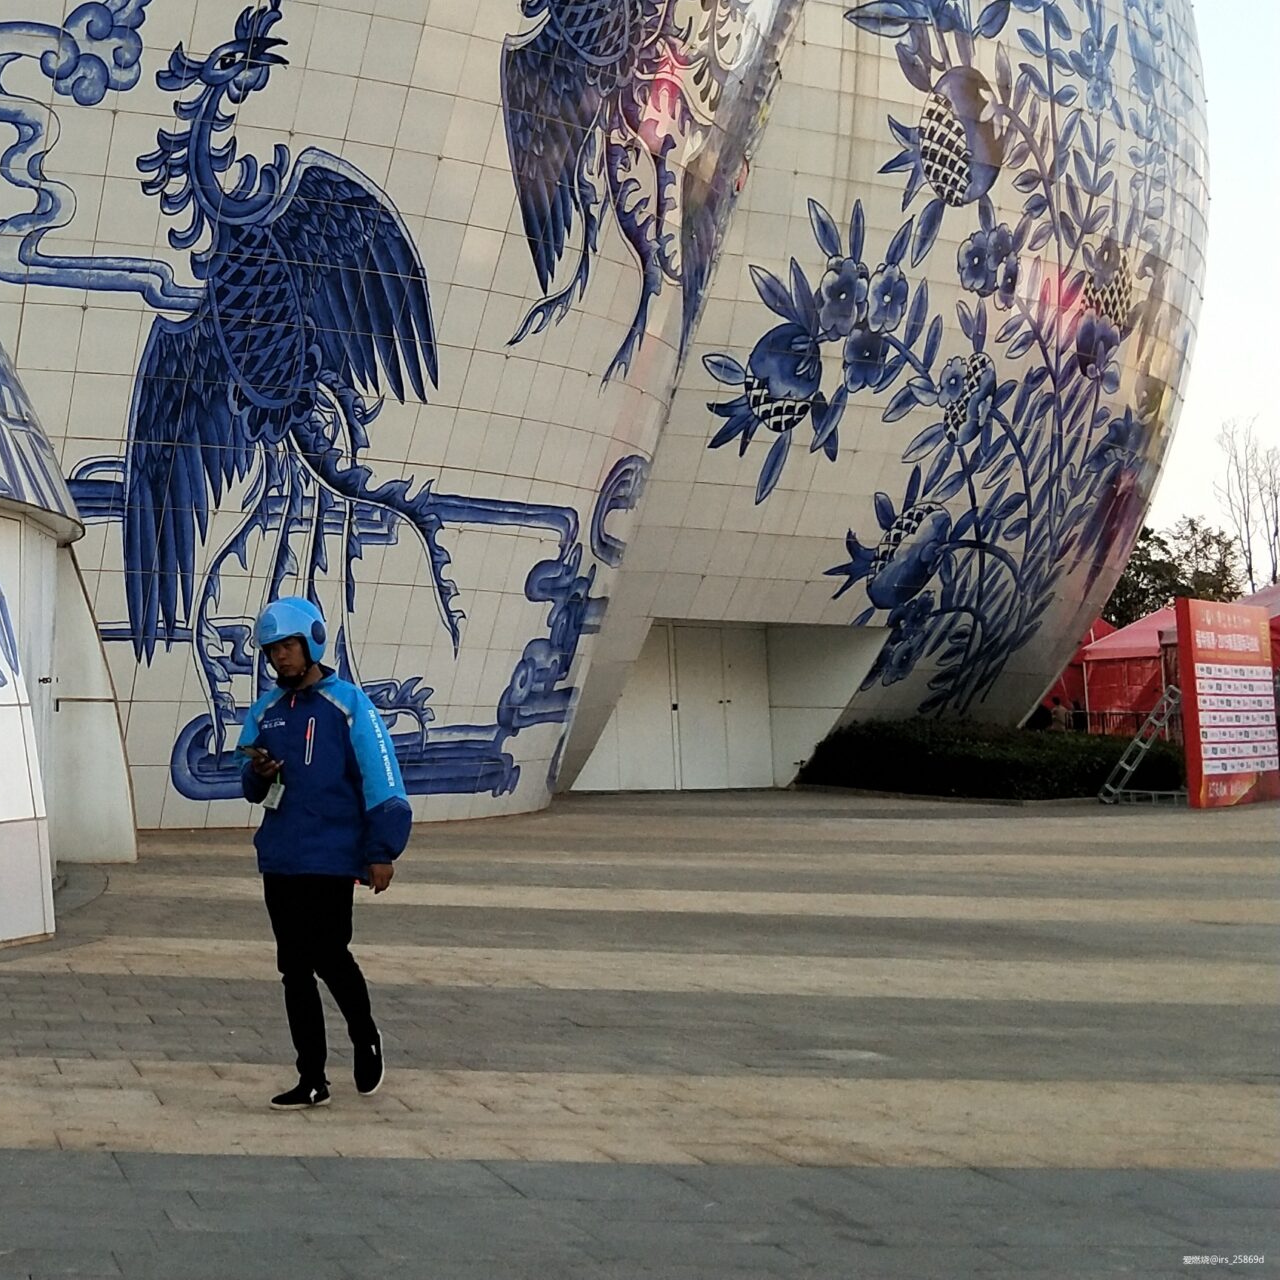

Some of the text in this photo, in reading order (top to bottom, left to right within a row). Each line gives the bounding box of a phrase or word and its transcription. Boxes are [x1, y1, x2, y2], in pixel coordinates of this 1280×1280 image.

[369, 710, 395, 787] DELIVER THE WONDER
